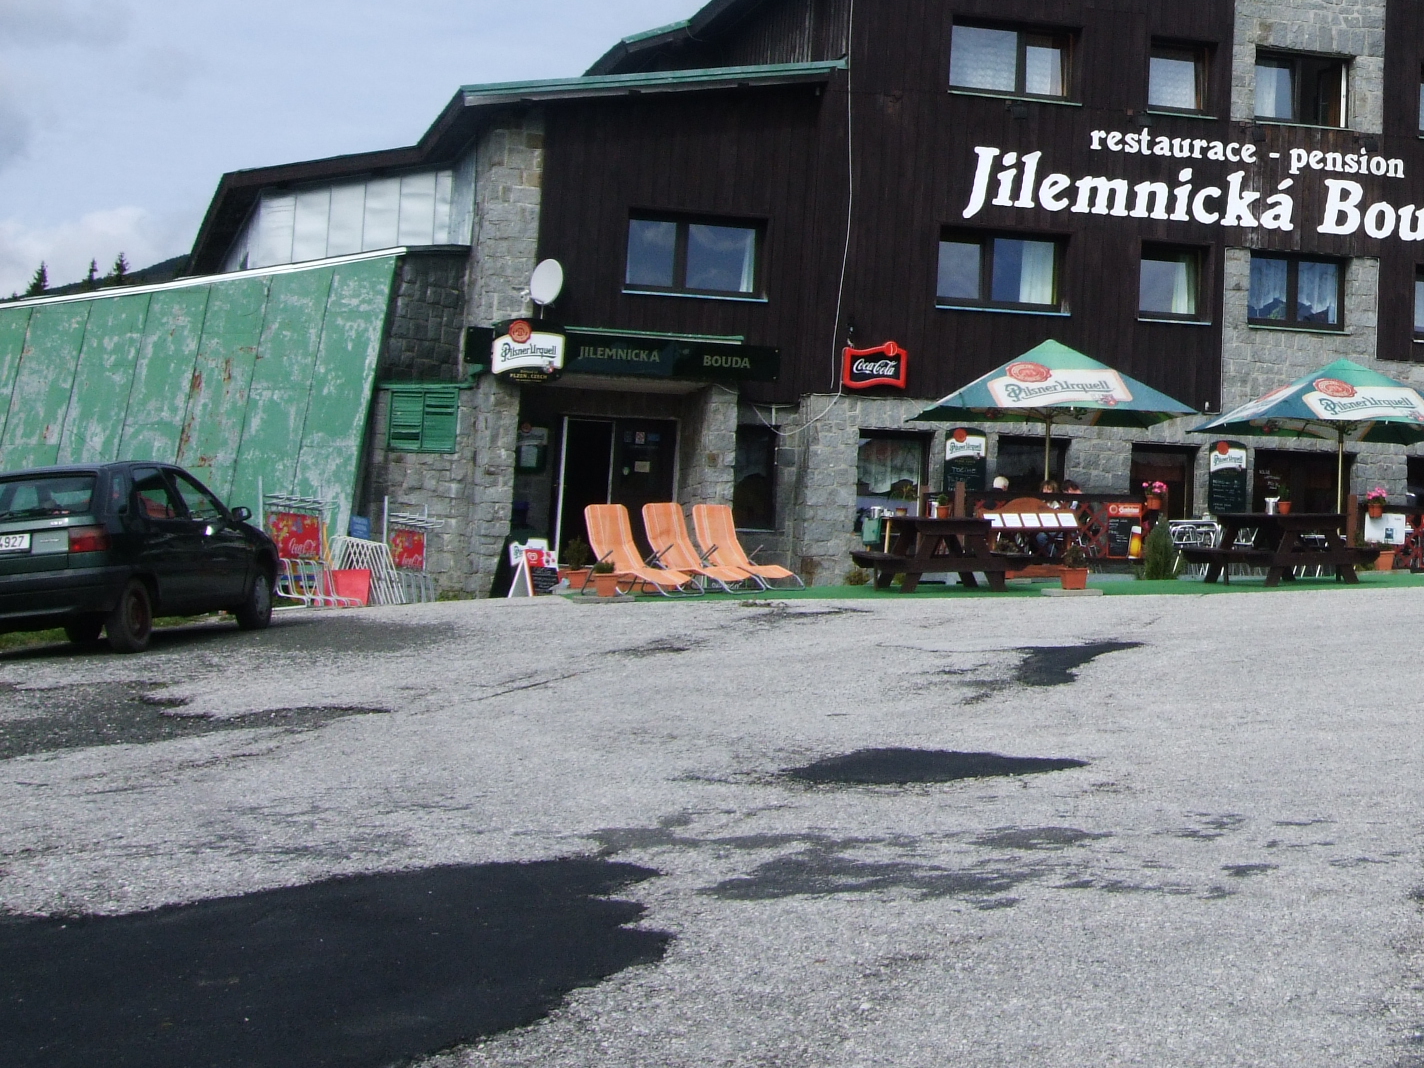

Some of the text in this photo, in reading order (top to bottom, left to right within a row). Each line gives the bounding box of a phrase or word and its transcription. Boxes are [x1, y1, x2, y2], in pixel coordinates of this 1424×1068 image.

[1090, 127, 1257, 163] restaurace
[1288, 147, 1406, 179] pension
[962, 146, 1294, 232] Jilemnická
[500, 342, 557, 362] Pilsner Urquell
[703, 355, 750, 369] BOUDA
[1003, 380, 1112, 403] Pilsner Urquell
[1318, 396, 1416, 416] Pilsner Urquell
